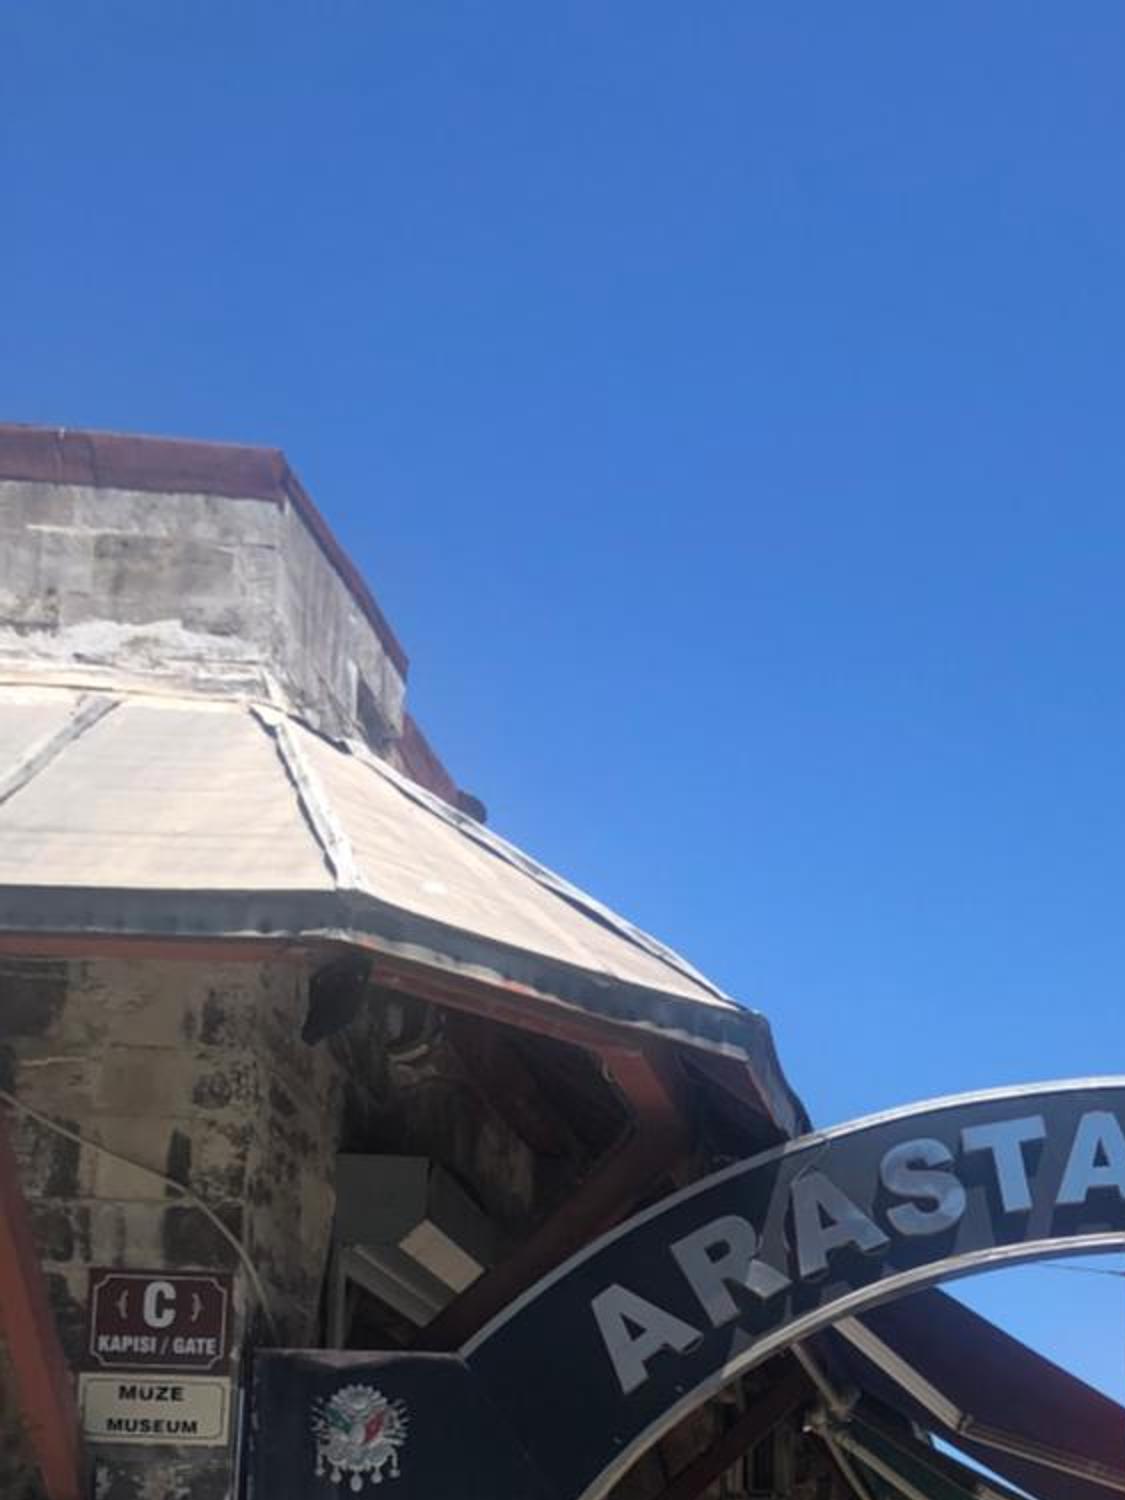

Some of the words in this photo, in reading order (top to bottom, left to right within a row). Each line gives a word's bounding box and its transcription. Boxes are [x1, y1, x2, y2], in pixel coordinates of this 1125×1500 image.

[143, 1281, 177, 1328] C
[98, 1335, 157, 1354] KAPISI
[172, 1336, 217, 1356] GATE
[118, 1385, 185, 1402] MUZE
[107, 1419, 198, 1434] MUSEUM
